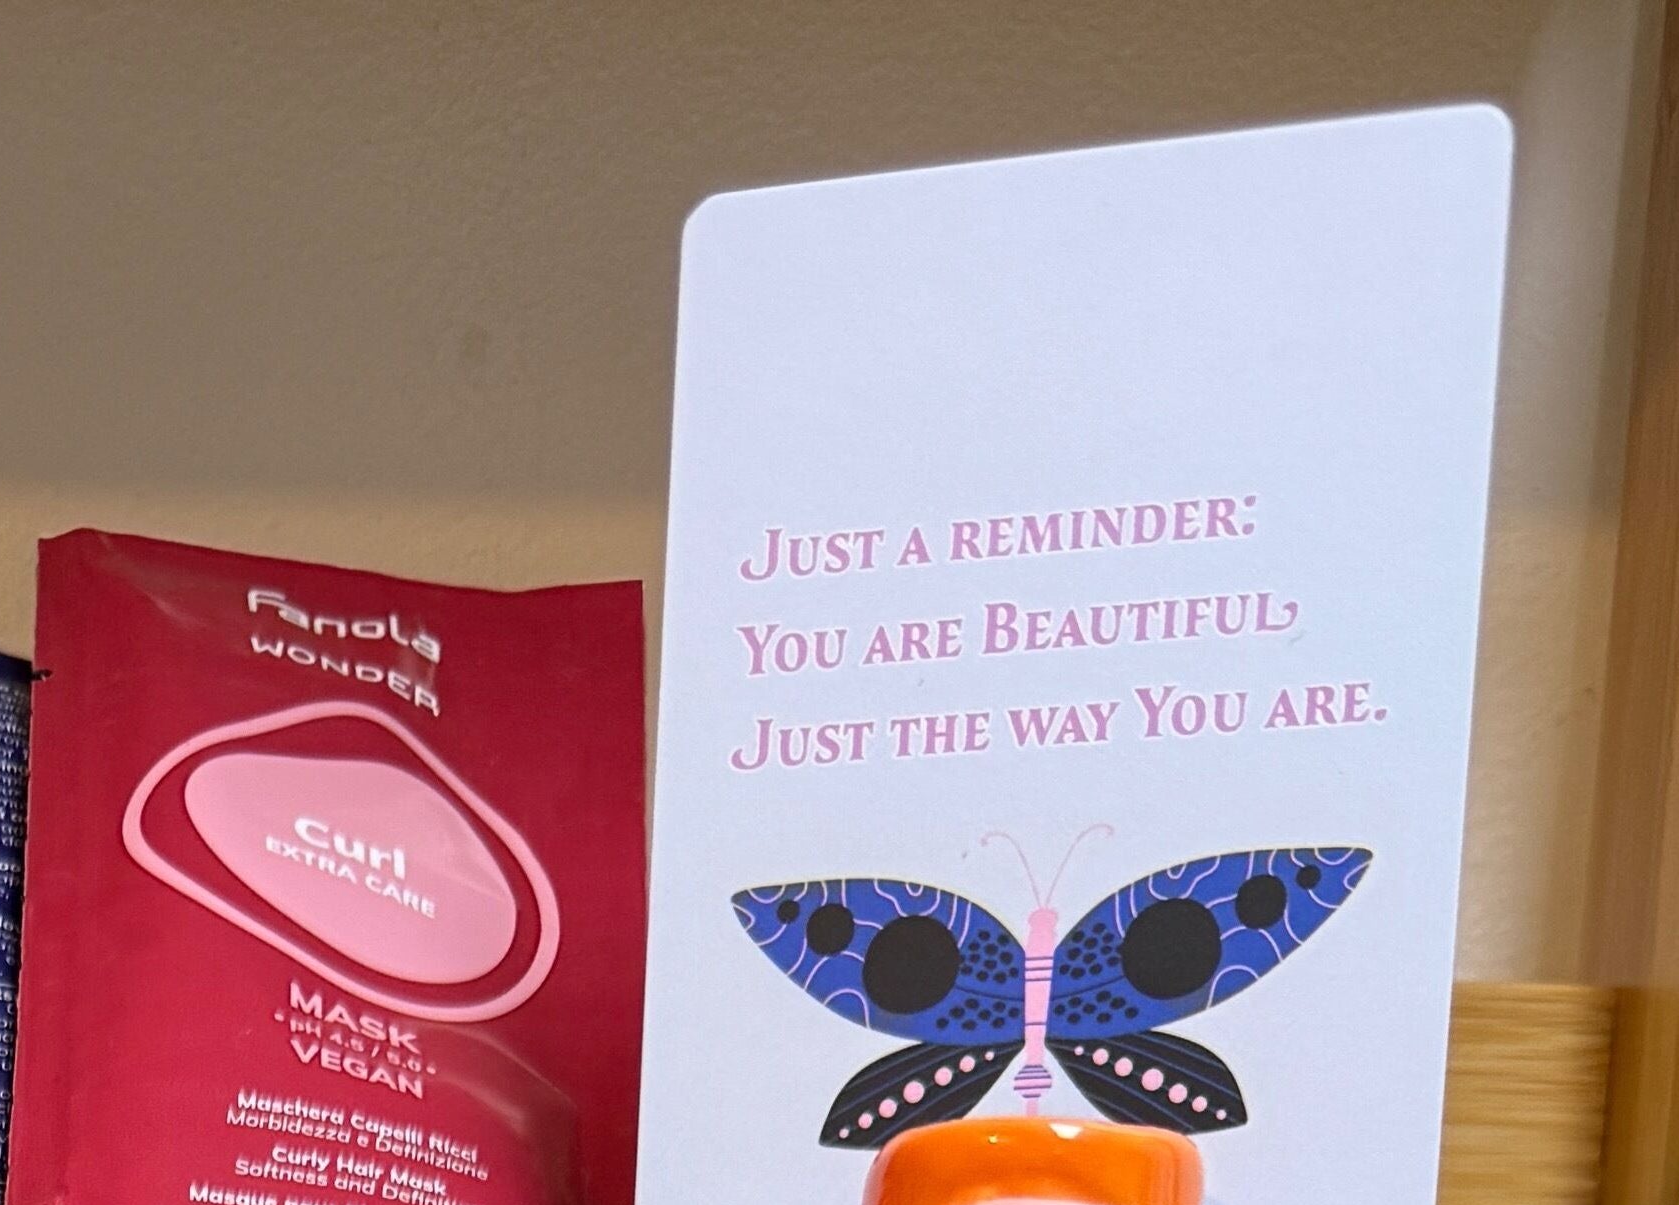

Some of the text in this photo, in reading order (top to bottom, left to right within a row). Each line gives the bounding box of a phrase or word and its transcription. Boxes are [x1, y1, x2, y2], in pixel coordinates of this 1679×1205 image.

[739, 494, 1258, 581] JUST A REMINDER:
[247, 588, 440, 664] Fanola
[737, 622, 848, 675] YOU
[863, 618, 962, 665] ARE
[250, 635, 441, 717] WONDER
[731, 719, 873, 770] JUST
[890, 711, 990, 758] THE
[1008, 702, 1120, 747] WAY
[1134, 684, 1249, 738] YOU
[266, 835, 436, 919] EXTRA CARE
[293, 816, 407, 881] Curl
[290, 981, 421, 1054] MASK
[290, 1040, 423, 1099] VEGAN
[226, 1109, 350, 1144] Morbidezza
[237, 1091, 345, 1127] Maschera
[235, 1158, 328, 1188] Softness
[334, 1173, 375, 1196] and
[272, 1146, 448, 1197] Curly Hair Mask
